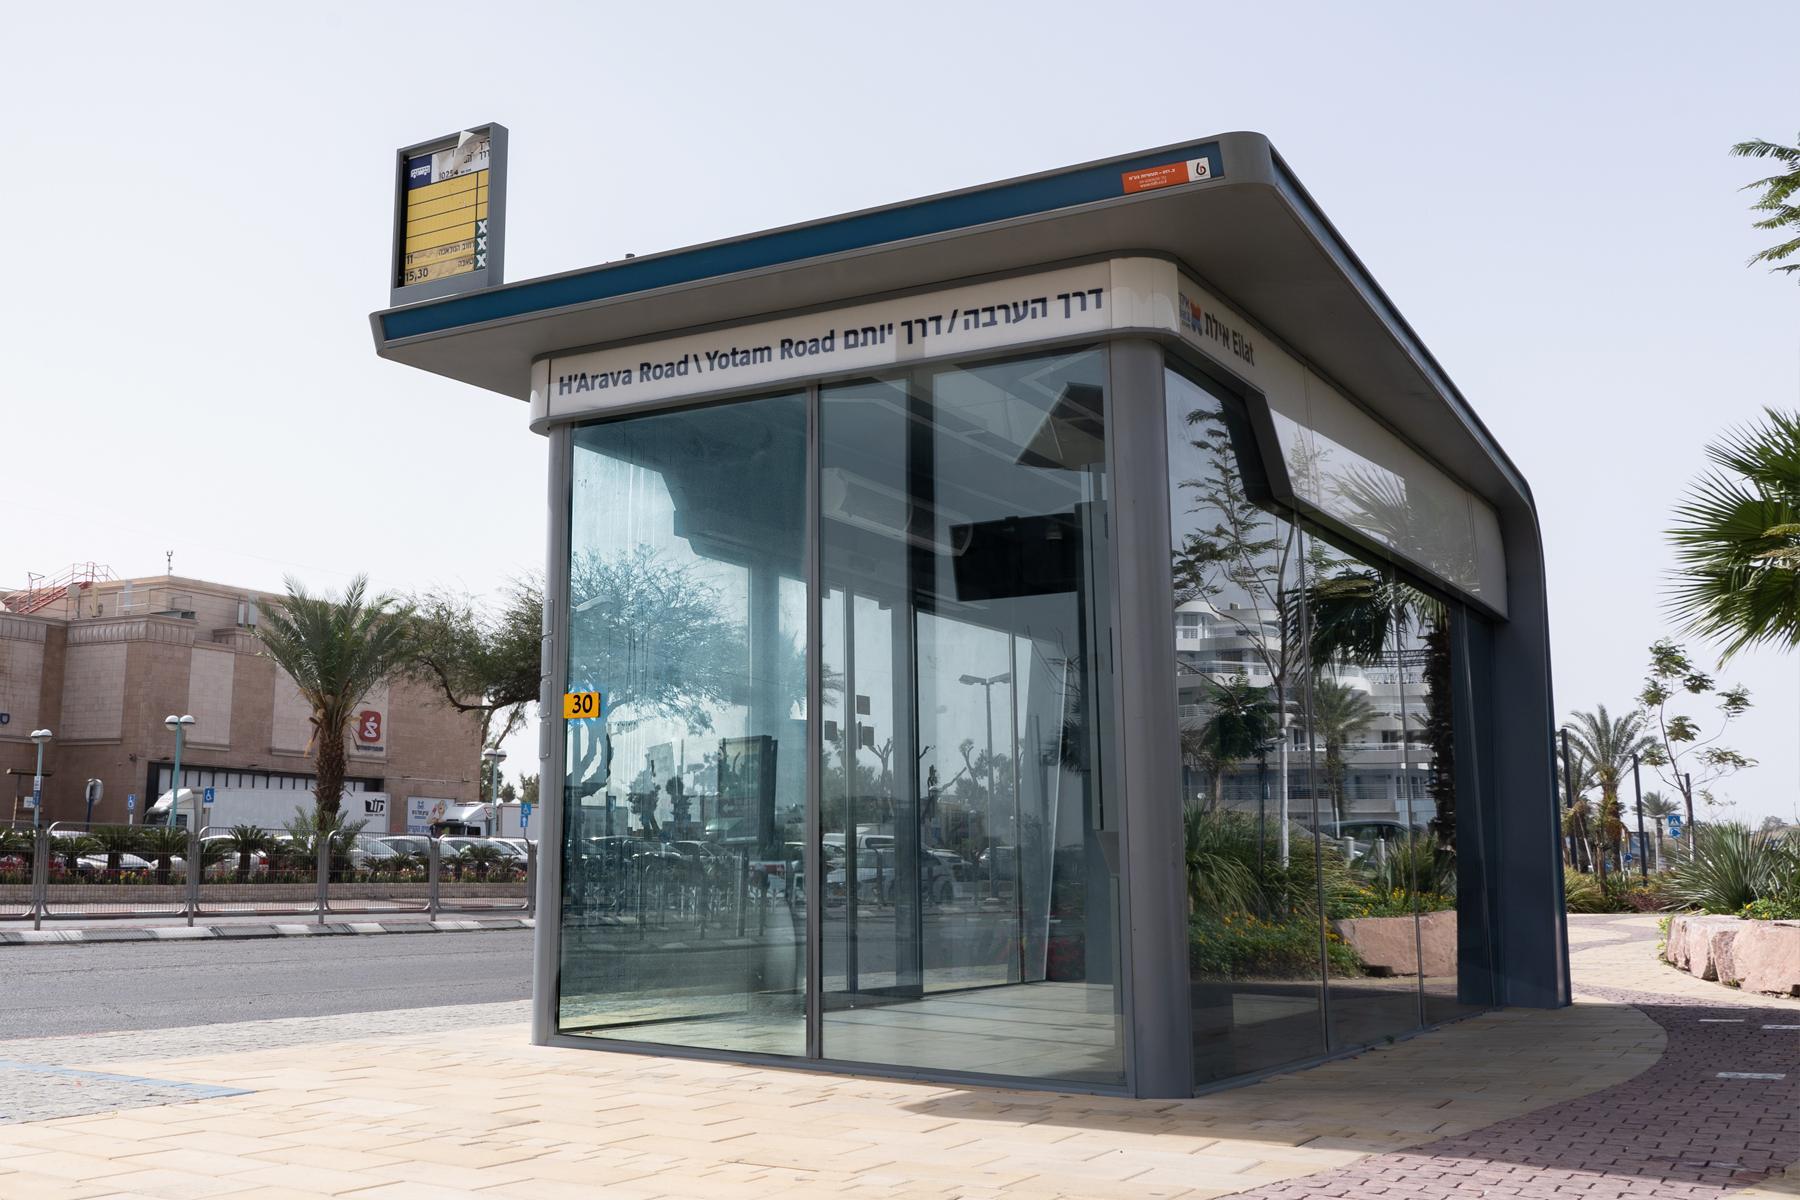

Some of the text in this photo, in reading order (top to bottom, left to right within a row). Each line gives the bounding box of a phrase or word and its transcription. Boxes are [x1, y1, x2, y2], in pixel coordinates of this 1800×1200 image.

[406, 267, 429, 282] 15,30
[407, 255, 414, 265] 11
[1057, 287, 1103, 319] דרך
[844, 322, 894, 349] יותם
[1204, 312, 1230, 350] אילת
[558, 368, 633, 396] H'Arava
[639, 354, 689, 383] Road
[705, 345, 772, 371] Yotam
[780, 329, 835, 360] Road
[1232, 330, 1255, 367] Eilat
[572, 694, 593, 714] 30
